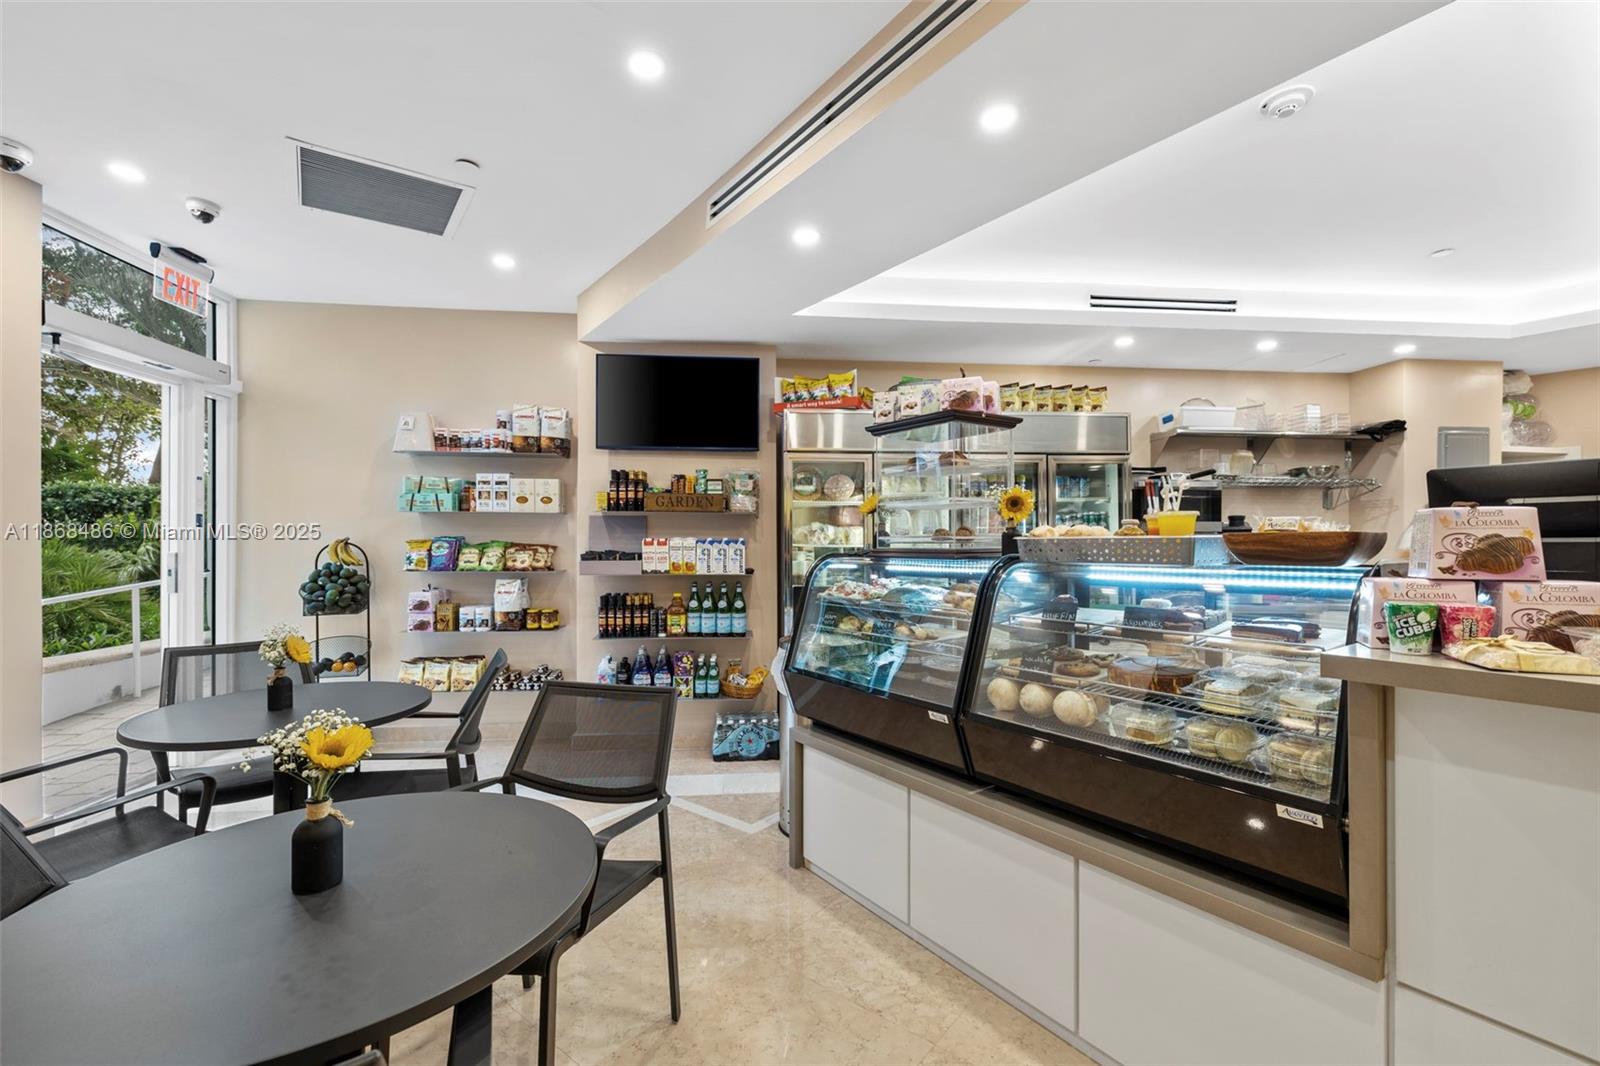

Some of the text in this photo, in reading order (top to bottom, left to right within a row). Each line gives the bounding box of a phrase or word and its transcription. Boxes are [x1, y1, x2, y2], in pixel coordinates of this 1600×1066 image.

[162, 266, 201, 311] EXIT
[655, 495, 714, 508] GARDEN
[1455, 517, 1520, 527] LA COLOMBA
[1394, 616, 1417, 628] ICE
[1396, 620, 1437, 638] CUBES
